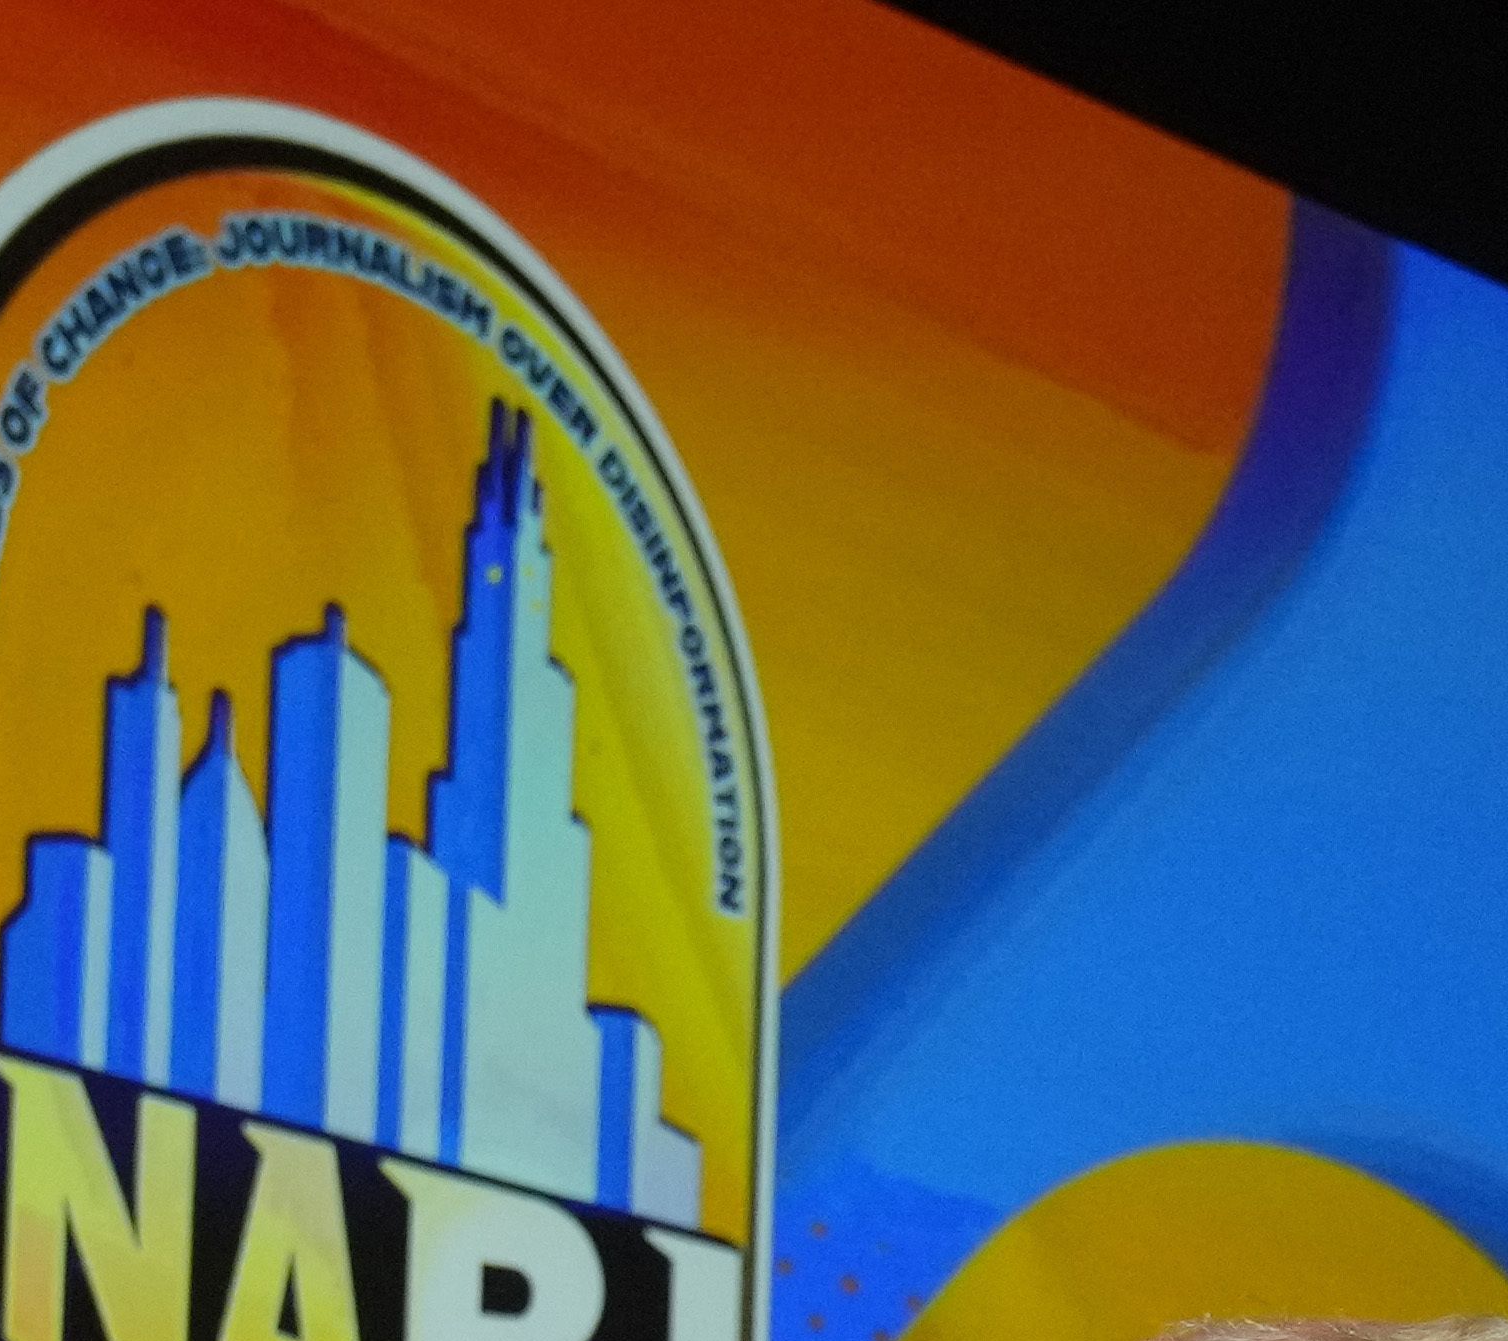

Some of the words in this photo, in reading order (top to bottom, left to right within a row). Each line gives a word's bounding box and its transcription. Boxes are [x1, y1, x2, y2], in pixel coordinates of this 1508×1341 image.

[0, 370, 45, 447] OF
[215, 218, 493, 340] JOURNALISM
[500, 327, 598, 448] OVER
[598, 446, 743, 914] DISINFORMATION
